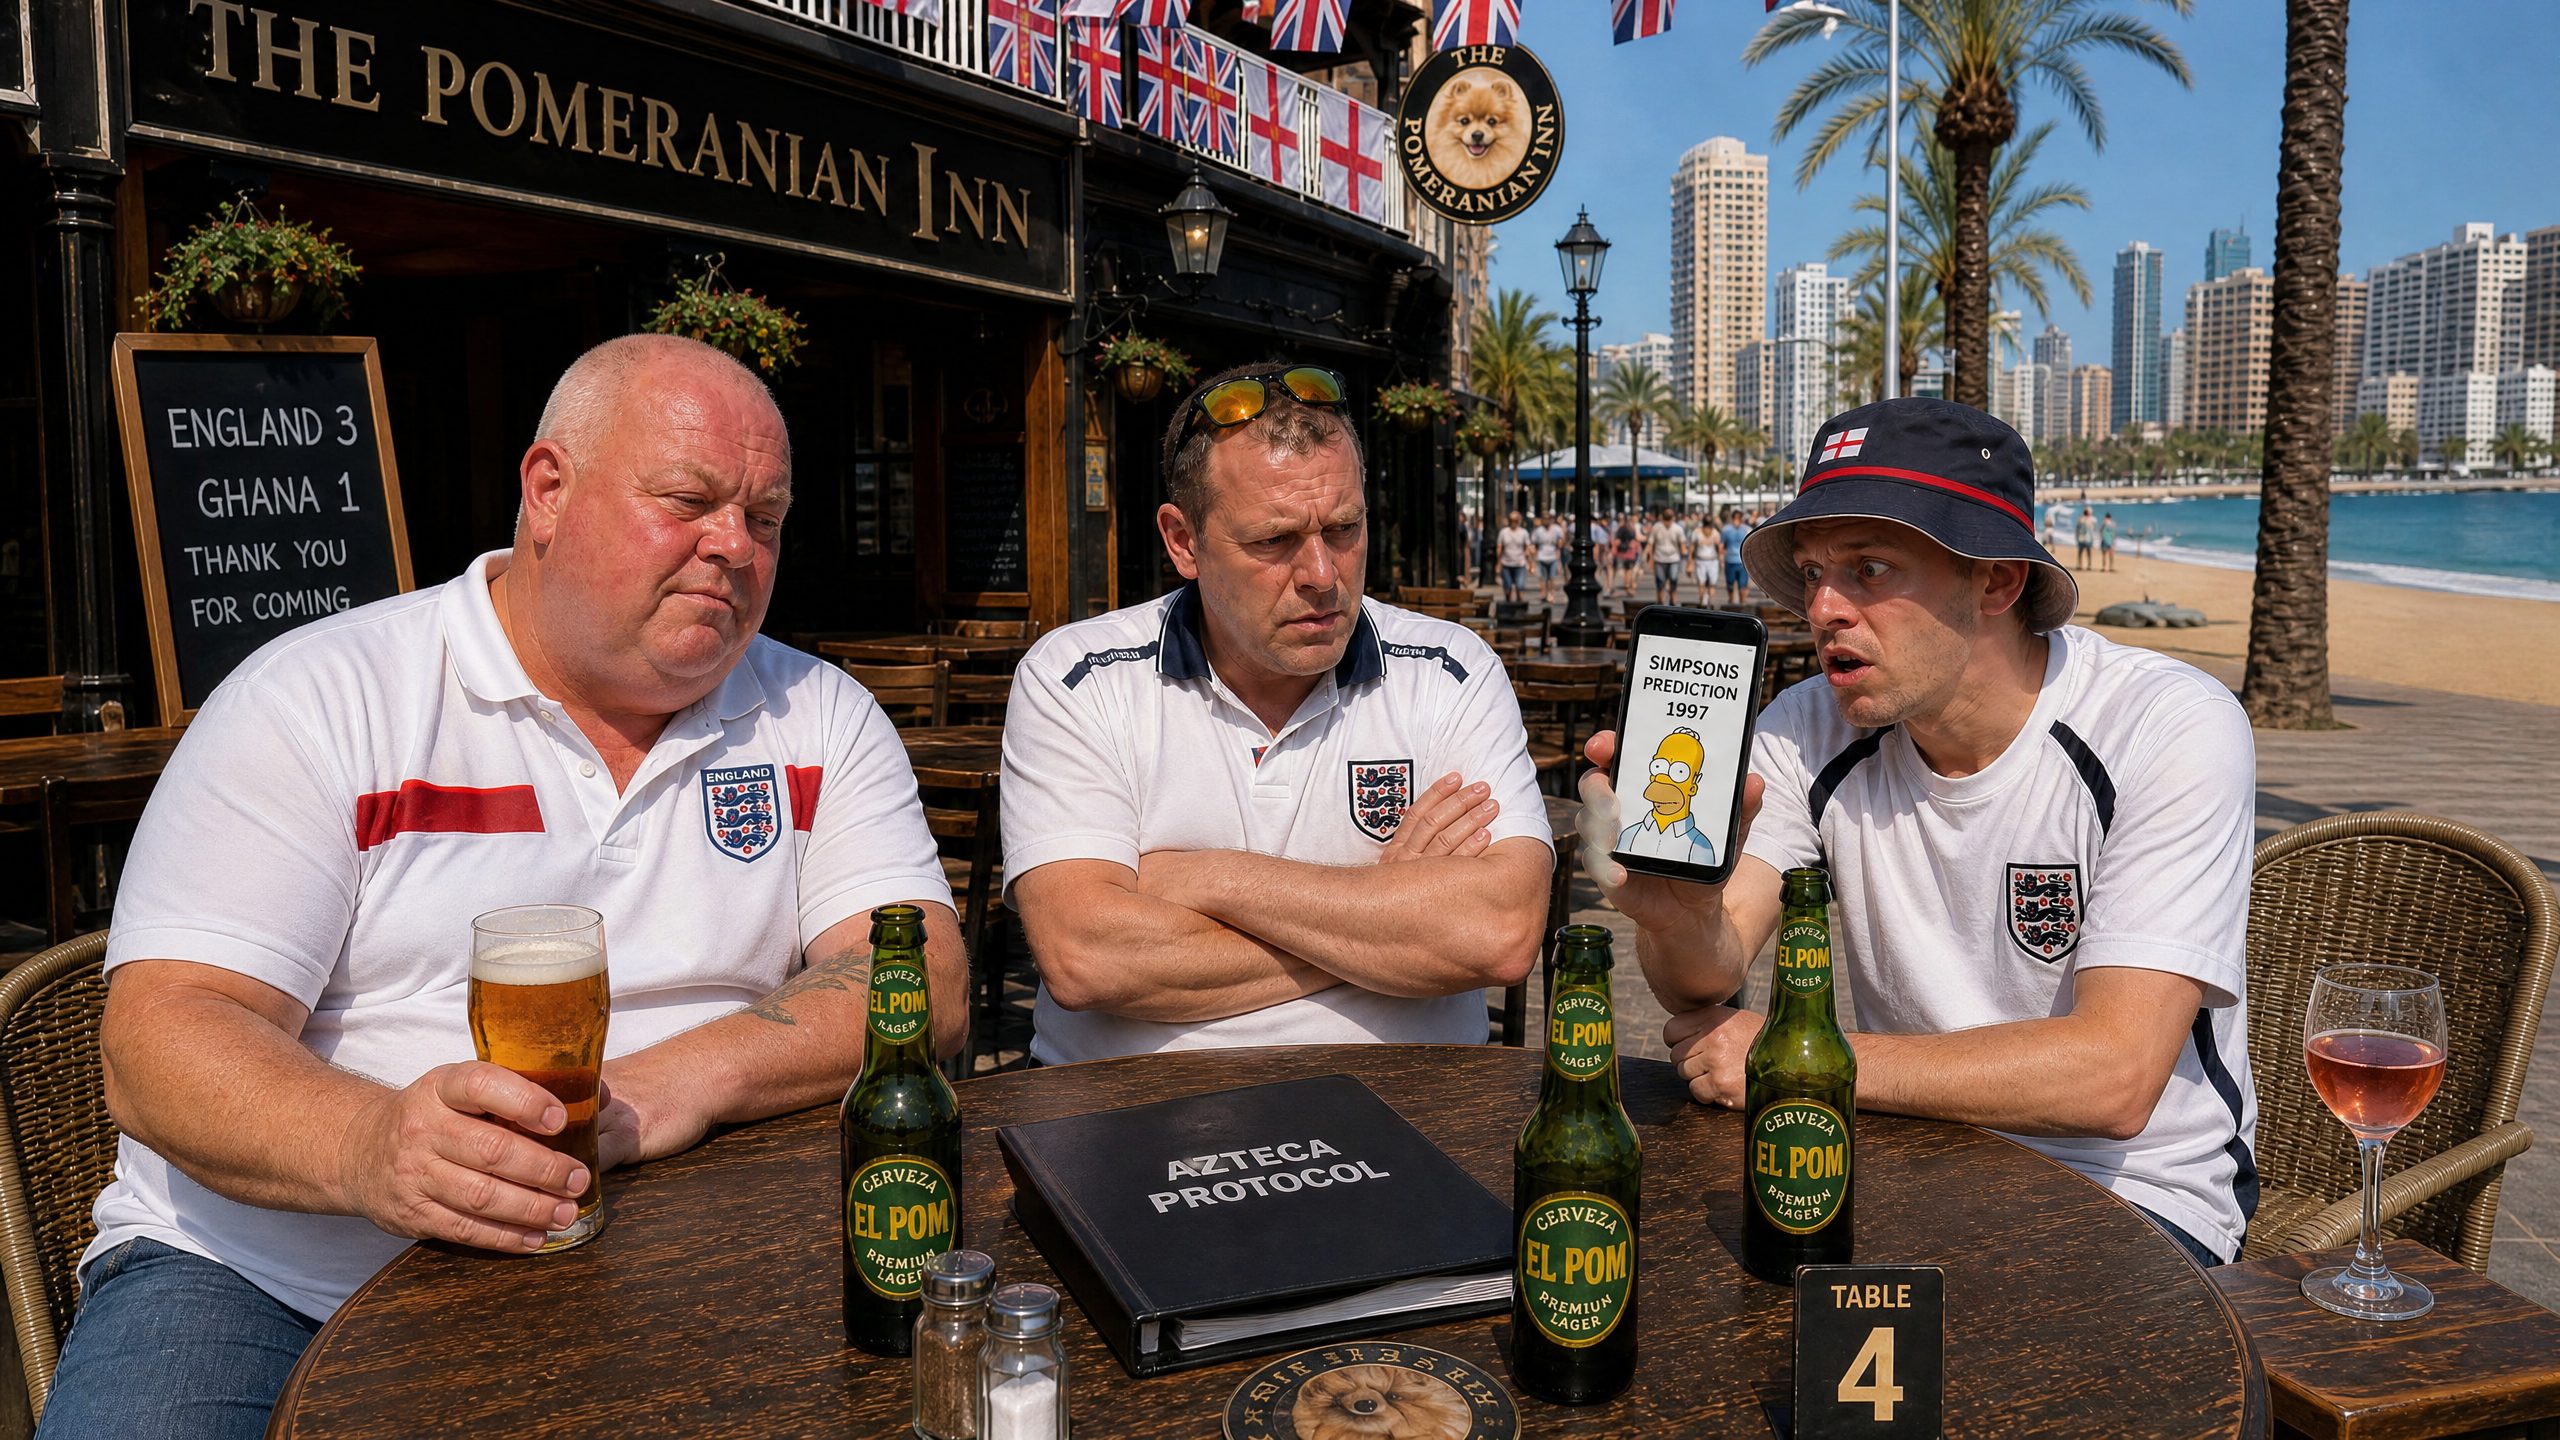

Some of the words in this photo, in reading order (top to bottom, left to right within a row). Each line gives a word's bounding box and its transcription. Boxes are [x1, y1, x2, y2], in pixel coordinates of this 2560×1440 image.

[1450, 45, 1506, 69] THE
[189, 0, 381, 112] THE
[421, 45, 890, 217] POMERANIAN
[911, 141, 1031, 249] INN
[1404, 117, 1541, 213] POMERANIAN
[1531, 103, 1555, 159] INN
[167, 407, 323, 448] ENGLAND
[335, 405, 358, 446] 3
[198, 475, 322, 518] GHANA
[338, 471, 360, 512] 1
[184, 542, 281, 576] THANK
[293, 538, 347, 569] YOU
[191, 596, 242, 628] FOR
[252, 586, 351, 620] COMING
[1649, 654, 1739, 680] SIMPSONS
[1643, 676, 1738, 701] PREDICTION
[1666, 701, 1709, 721] 1997
[706, 767, 770, 783] ENGLAND
[1782, 926, 1826, 943] CERVEZA
[1778, 945, 1793, 968] EL
[1796, 946, 1830, 969] POM
[874, 970, 922, 987] CERVEZA
[870, 989, 886, 1014] EL
[889, 988, 927, 1014] POM
[1556, 998, 1606, 1015] CERVEZA
[1551, 1018, 1569, 1046] EL
[1572, 1019, 1612, 1047] POM
[1765, 1111, 1835, 1136] CERVEZA
[1168, 1139, 1342, 1181] AZTECA
[1756, 1140, 1782, 1177] EL
[1789, 1143, 1844, 1180] POM
[862, 1168, 938, 1194] CERVEZA
[1148, 1160, 1391, 1214] PROTOCOL
[854, 1201, 882, 1240] EL
[889, 1199, 949, 1241] POM
[1536, 1206, 1617, 1235] CERVEZA
[1777, 1204, 1822, 1221] LAGER
[1526, 1238, 1557, 1283] EL
[1564, 1240, 1627, 1285] POM
[1830, 1284, 1911, 1309] TABLE
[1550, 1312, 1602, 1331] LAGER
[1838, 1327, 1904, 1421] 4
